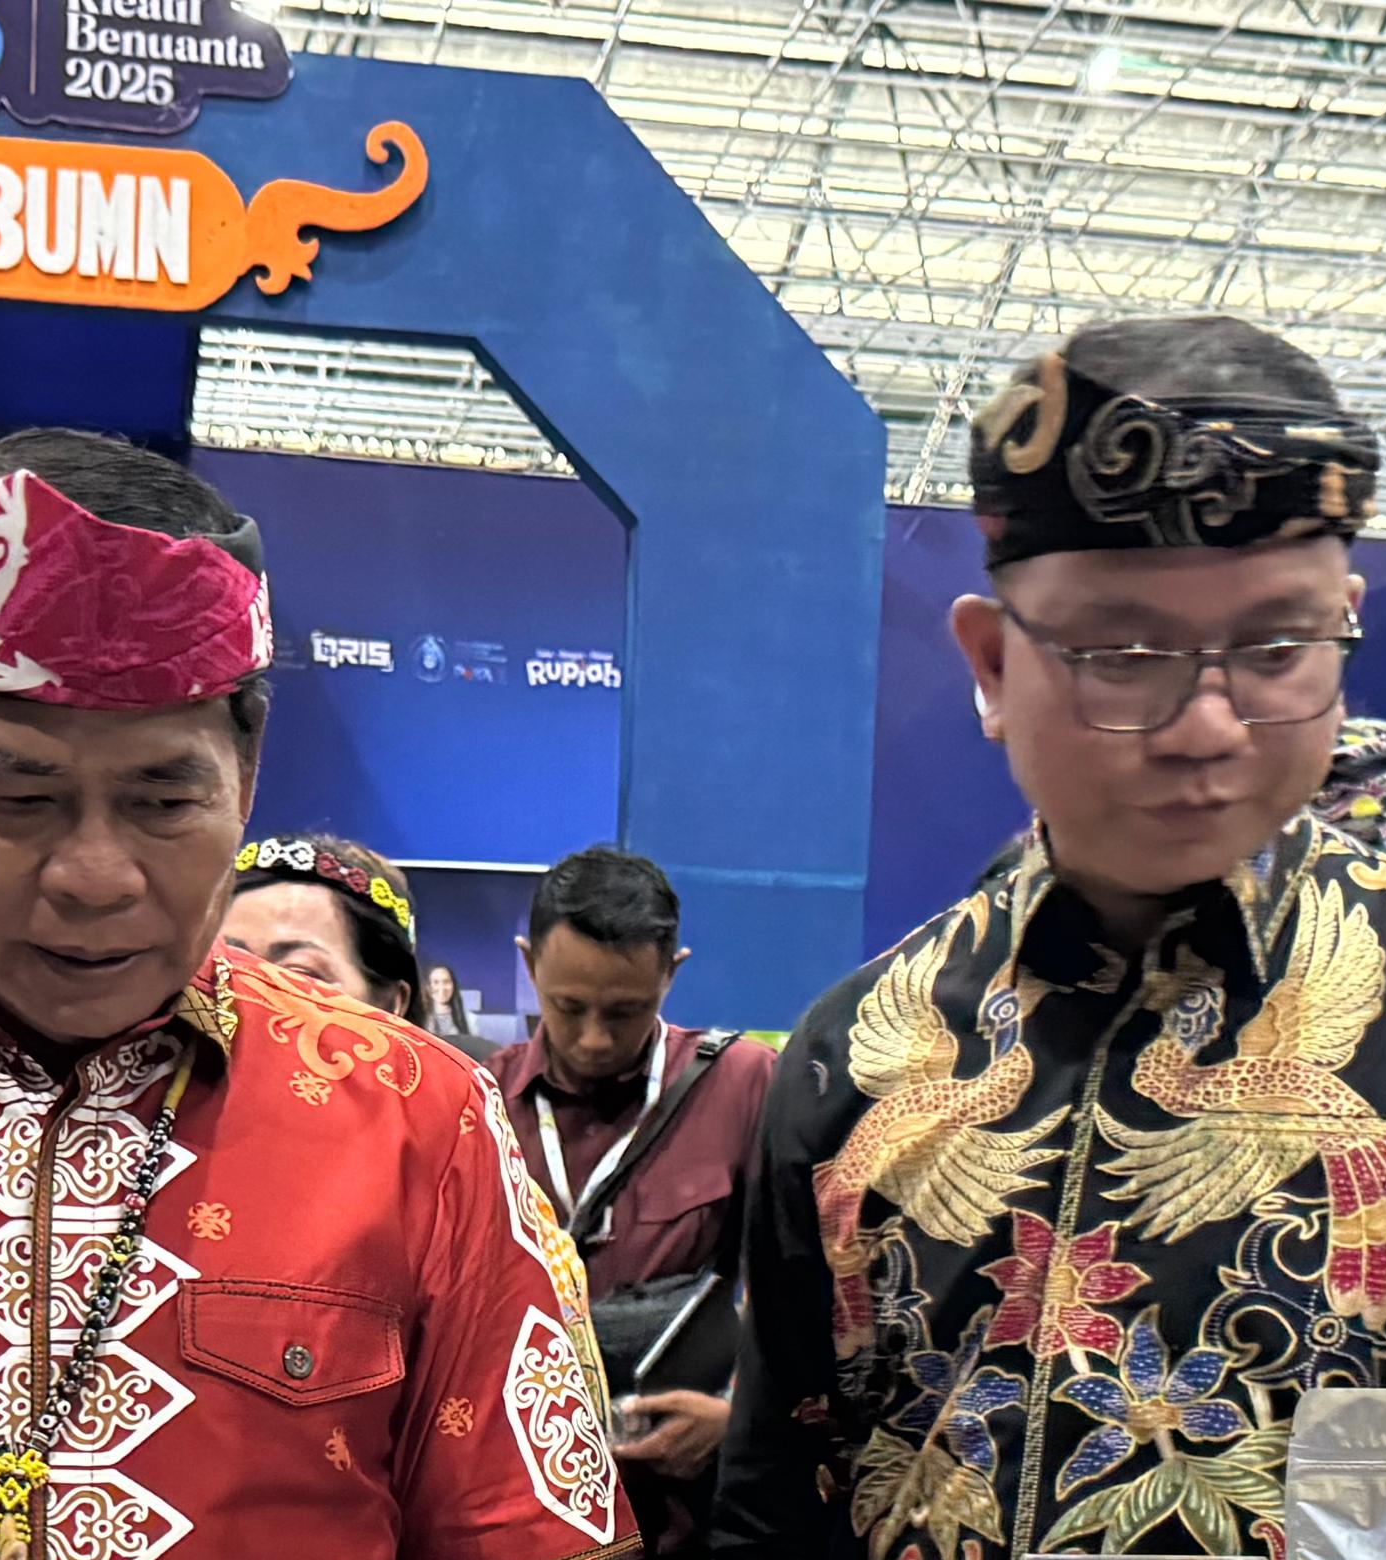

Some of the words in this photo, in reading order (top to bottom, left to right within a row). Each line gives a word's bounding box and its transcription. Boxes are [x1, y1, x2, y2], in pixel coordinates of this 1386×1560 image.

[66, 12, 264, 69] Benuanta
[64, 58, 175, 105] 2025
[312, 634, 394, 672] QRIS
[526, 659, 621, 688] Rupiah
